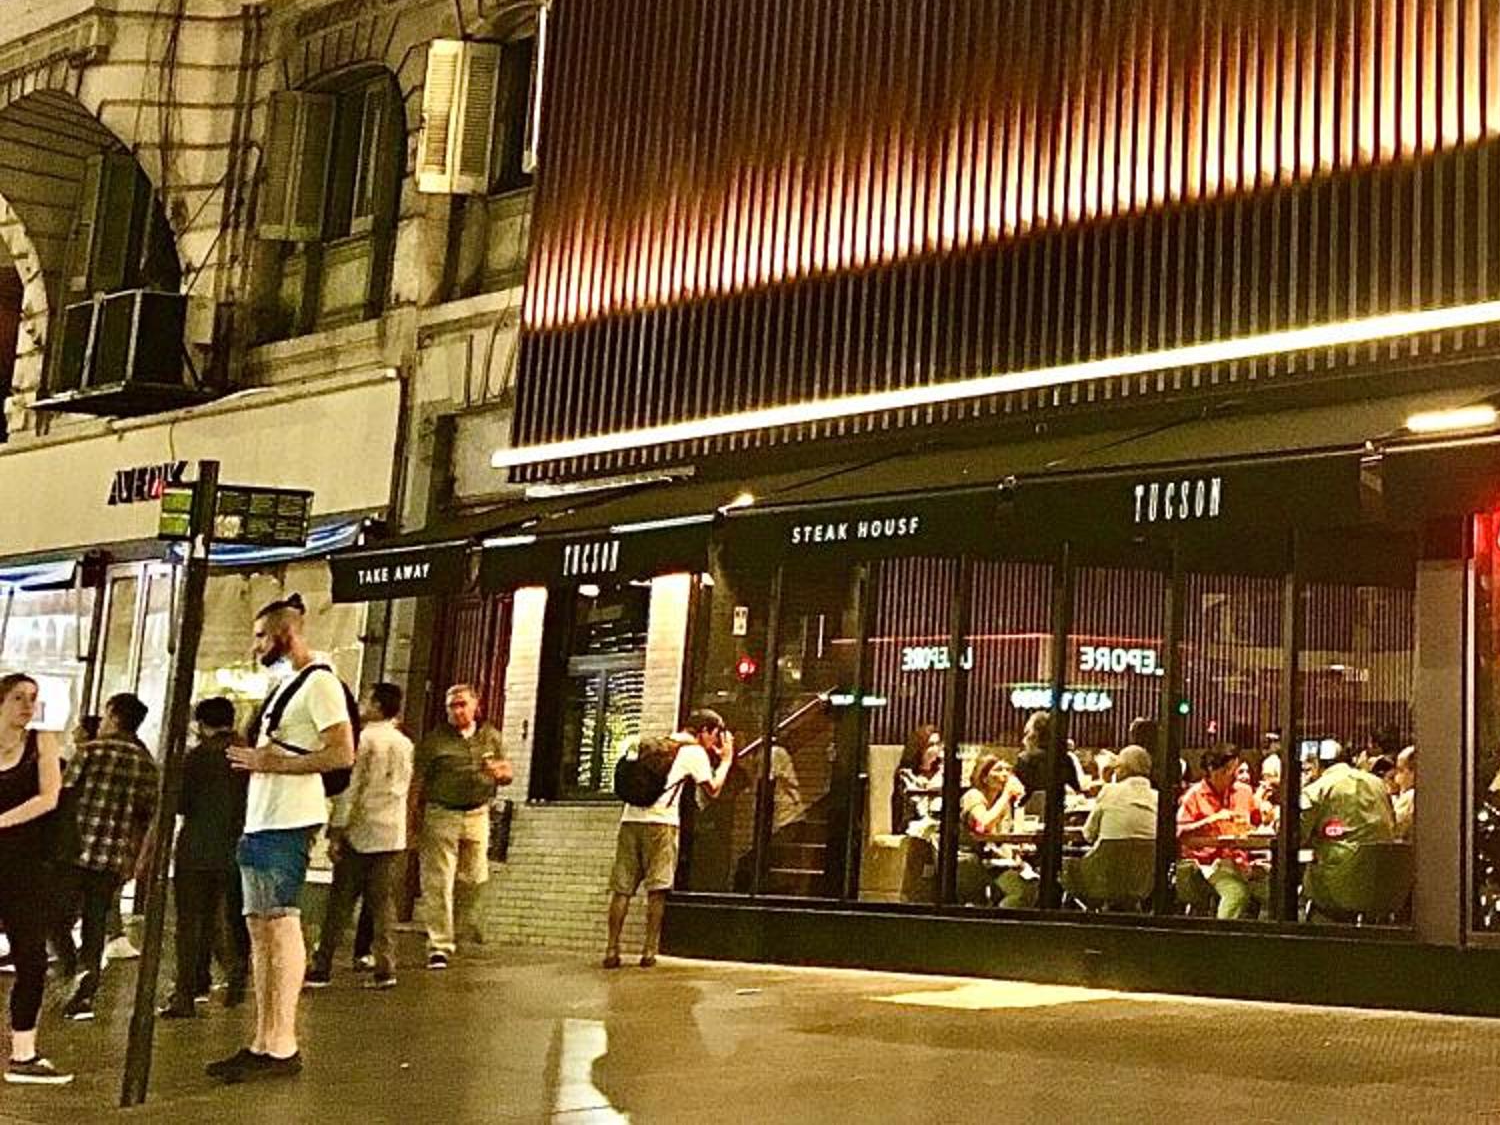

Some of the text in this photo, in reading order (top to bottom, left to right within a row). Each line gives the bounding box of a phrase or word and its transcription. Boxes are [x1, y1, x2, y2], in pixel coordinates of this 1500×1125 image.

[1134, 477, 1222, 523] TUCSON
[792, 523, 848, 545] STEAK
[357, 562, 431, 585] TAKE AWAY
